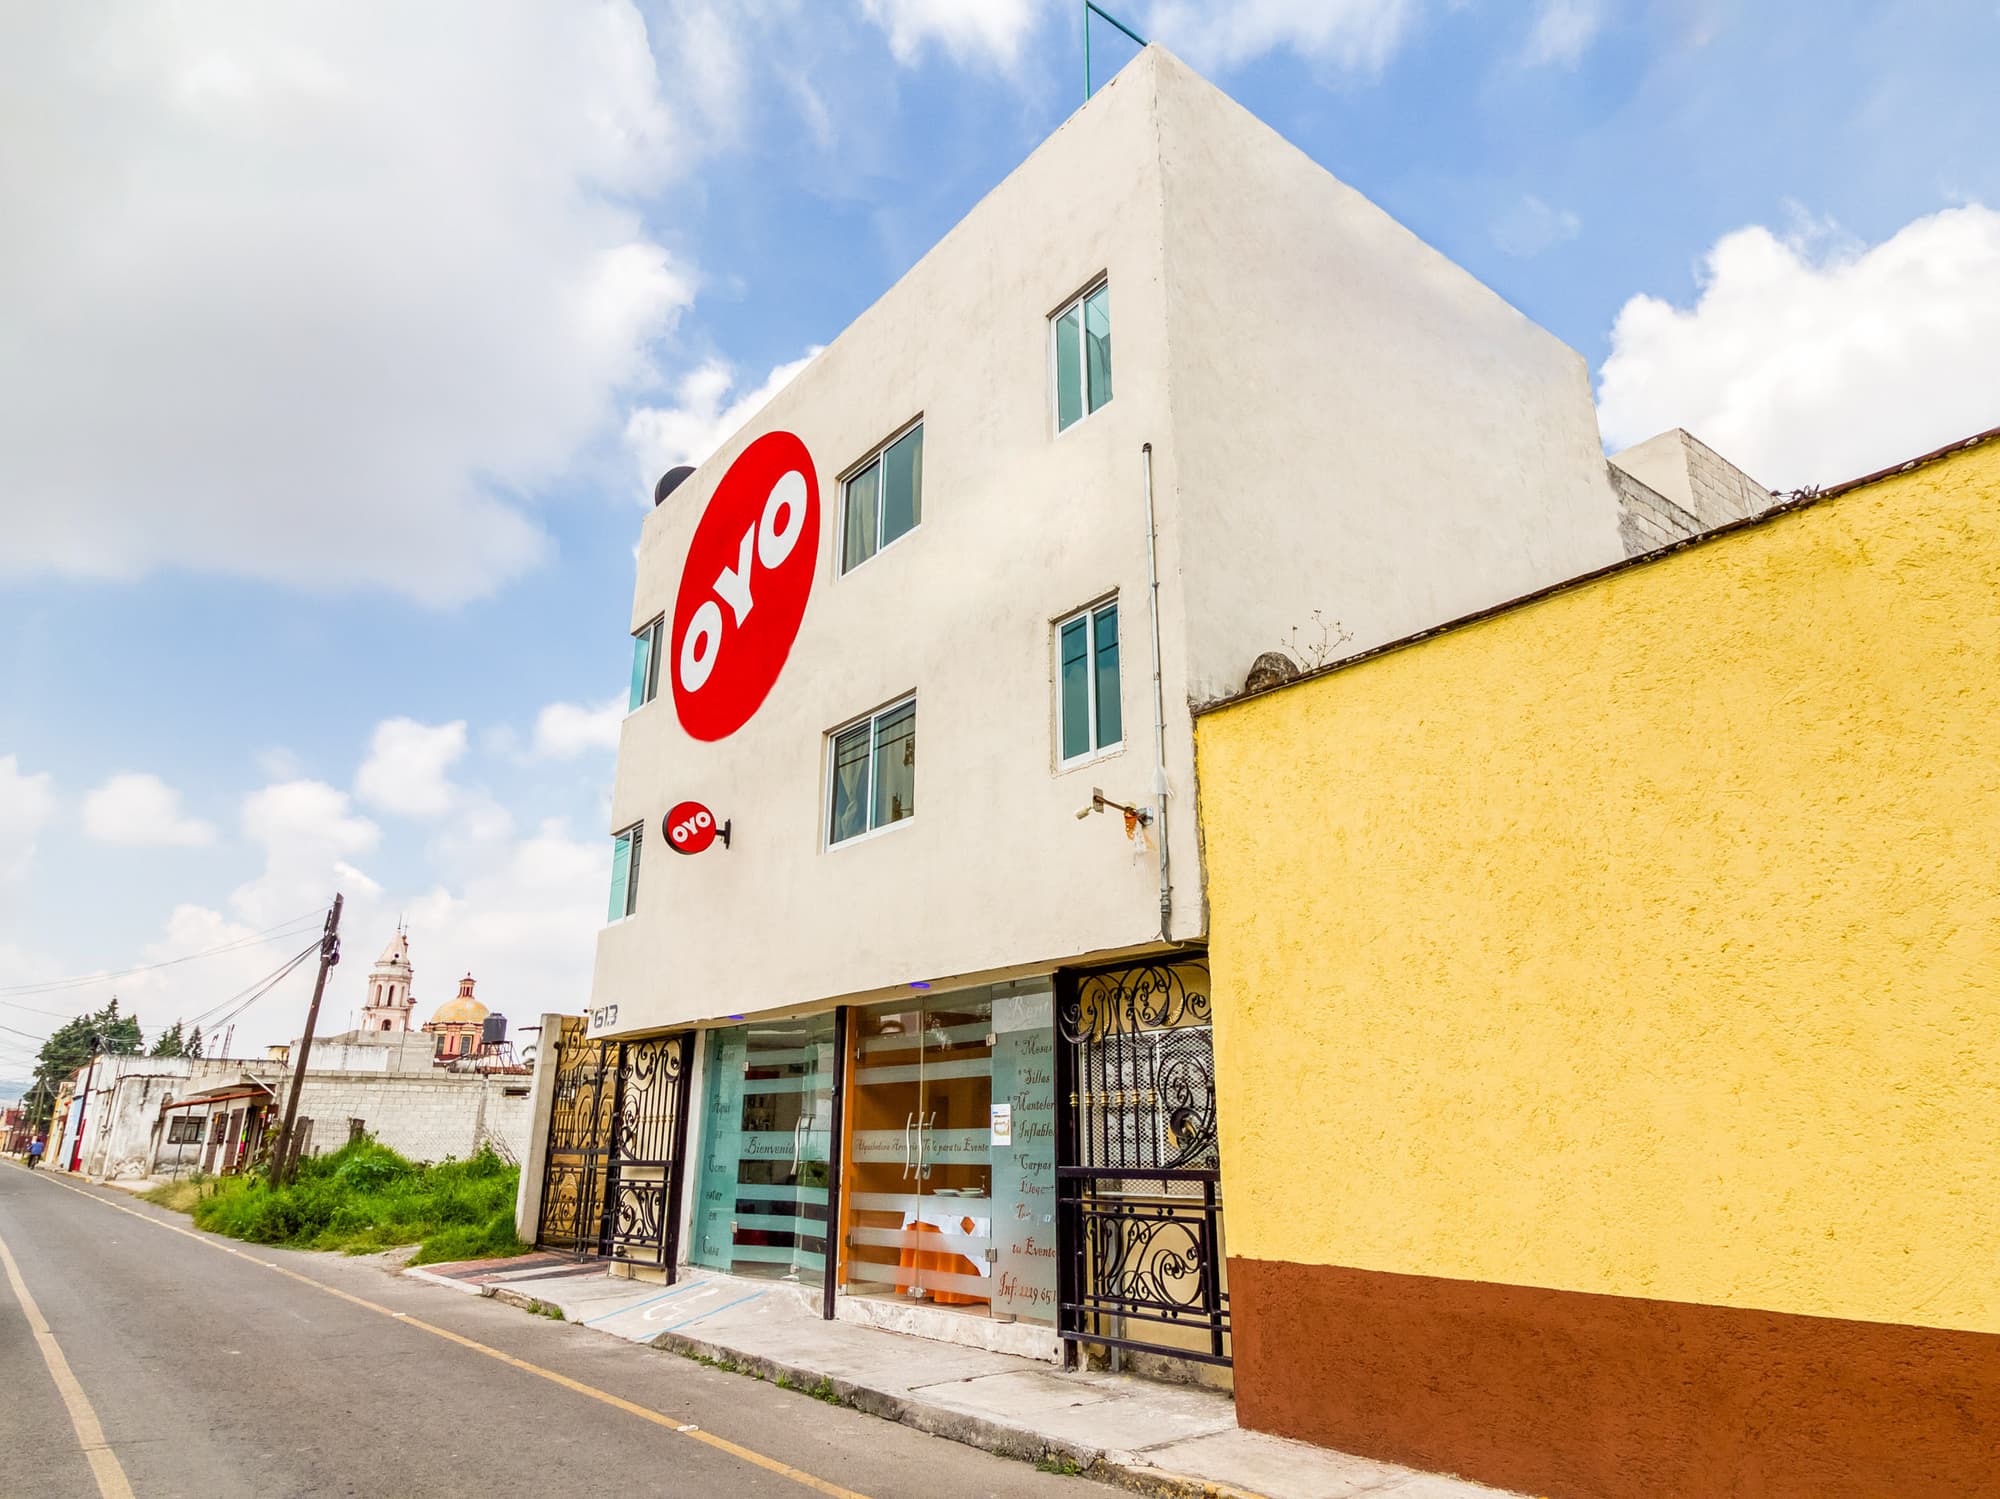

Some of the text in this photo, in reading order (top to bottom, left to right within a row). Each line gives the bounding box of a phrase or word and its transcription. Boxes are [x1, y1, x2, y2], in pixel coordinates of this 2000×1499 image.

[680, 470, 808, 693] OYO
[672, 811, 711, 843] OYO
[1024, 1068, 1050, 1085] Sillas
[1011, 1090, 1055, 1112] Manteler
